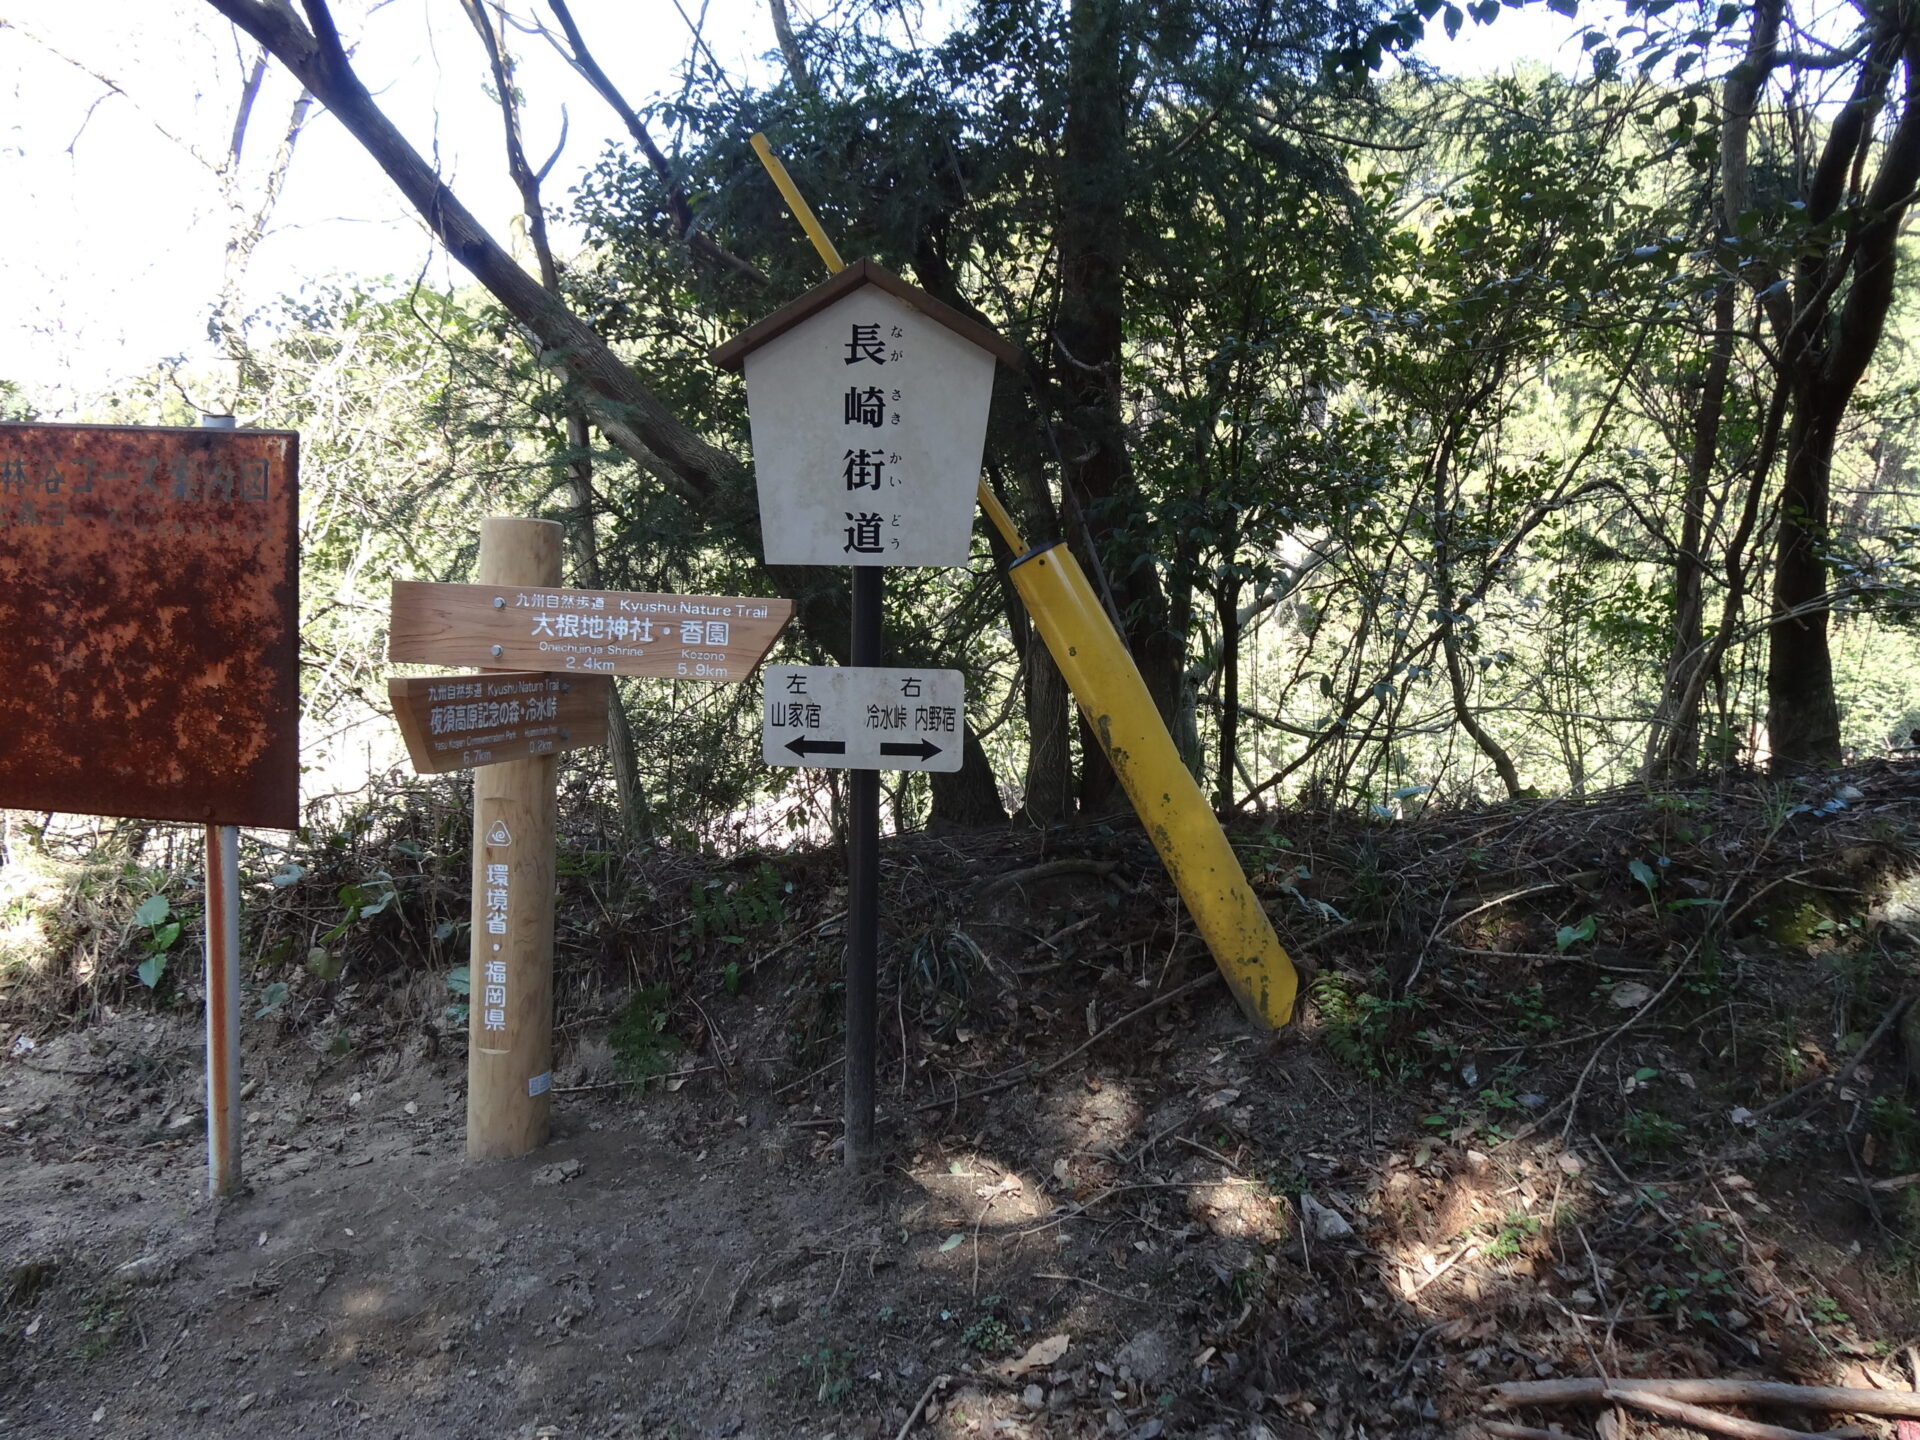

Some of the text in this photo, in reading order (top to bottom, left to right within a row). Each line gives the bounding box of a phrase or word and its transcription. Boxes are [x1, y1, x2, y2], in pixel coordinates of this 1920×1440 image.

[842, 322, 887, 554] 長崎街道
[515, 592, 769, 619] 九州自然歩道 Kyushu Nature Trail
[531, 612, 730, 646] 大根地神社・香園
[606, 645, 645, 658] Shrine
[680, 649, 726, 662] Kozono
[565, 655, 615, 671] 2.4km
[677, 662, 728, 678] 5.9km
[428, 683, 483, 702] 九州自然歩道
[488, 682, 516, 697] Kyushu
[517, 681, 544, 693] Nature
[786, 673, 808, 694] 左
[900, 677, 922, 698] 右
[771, 701, 822, 728] 山家宿
[866, 703, 957, 732] 冷水峠 内野宿
[463, 749, 492, 765] 6.7km
[529, 739, 553, 754] 0.2km
[484, 863, 509, 1031] 環境省・福岡県
